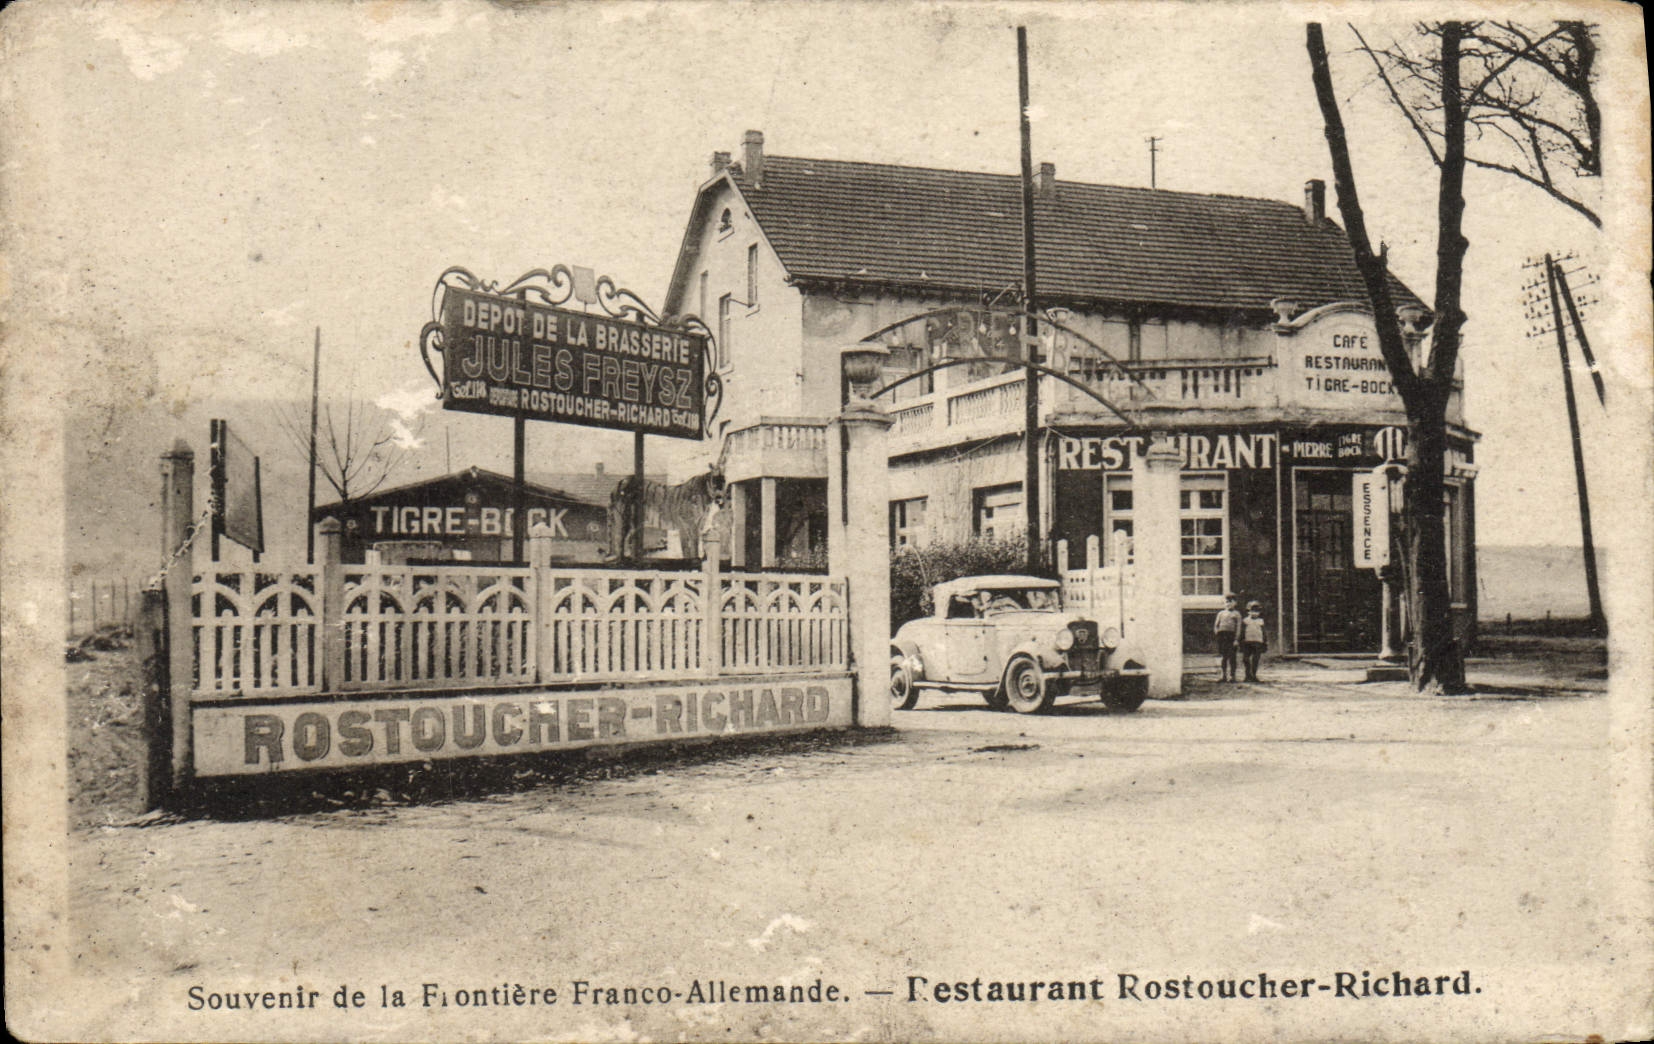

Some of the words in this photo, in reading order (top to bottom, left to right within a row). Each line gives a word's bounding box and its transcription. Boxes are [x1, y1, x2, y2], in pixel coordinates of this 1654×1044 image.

[463, 299, 524, 336] DEPOT
[533, 312, 557, 342] DE
[567, 319, 588, 347] LA
[596, 324, 690, 364] BRASSERIE
[462, 335, 574, 391] JULES
[583, 353, 693, 409] FREYSZ
[1305, 355, 1387, 371] RESTAURAN
[521, 388, 670, 427] ROSTOUCHER-RICHARD
[1058, 433, 1276, 470] RESTURANT
[1338, 445, 1362, 458] BOCK
[1362, 482, 1372, 560] ESSENCE
[243, 686, 830, 765] ROSTOUCHER-RICHARD
